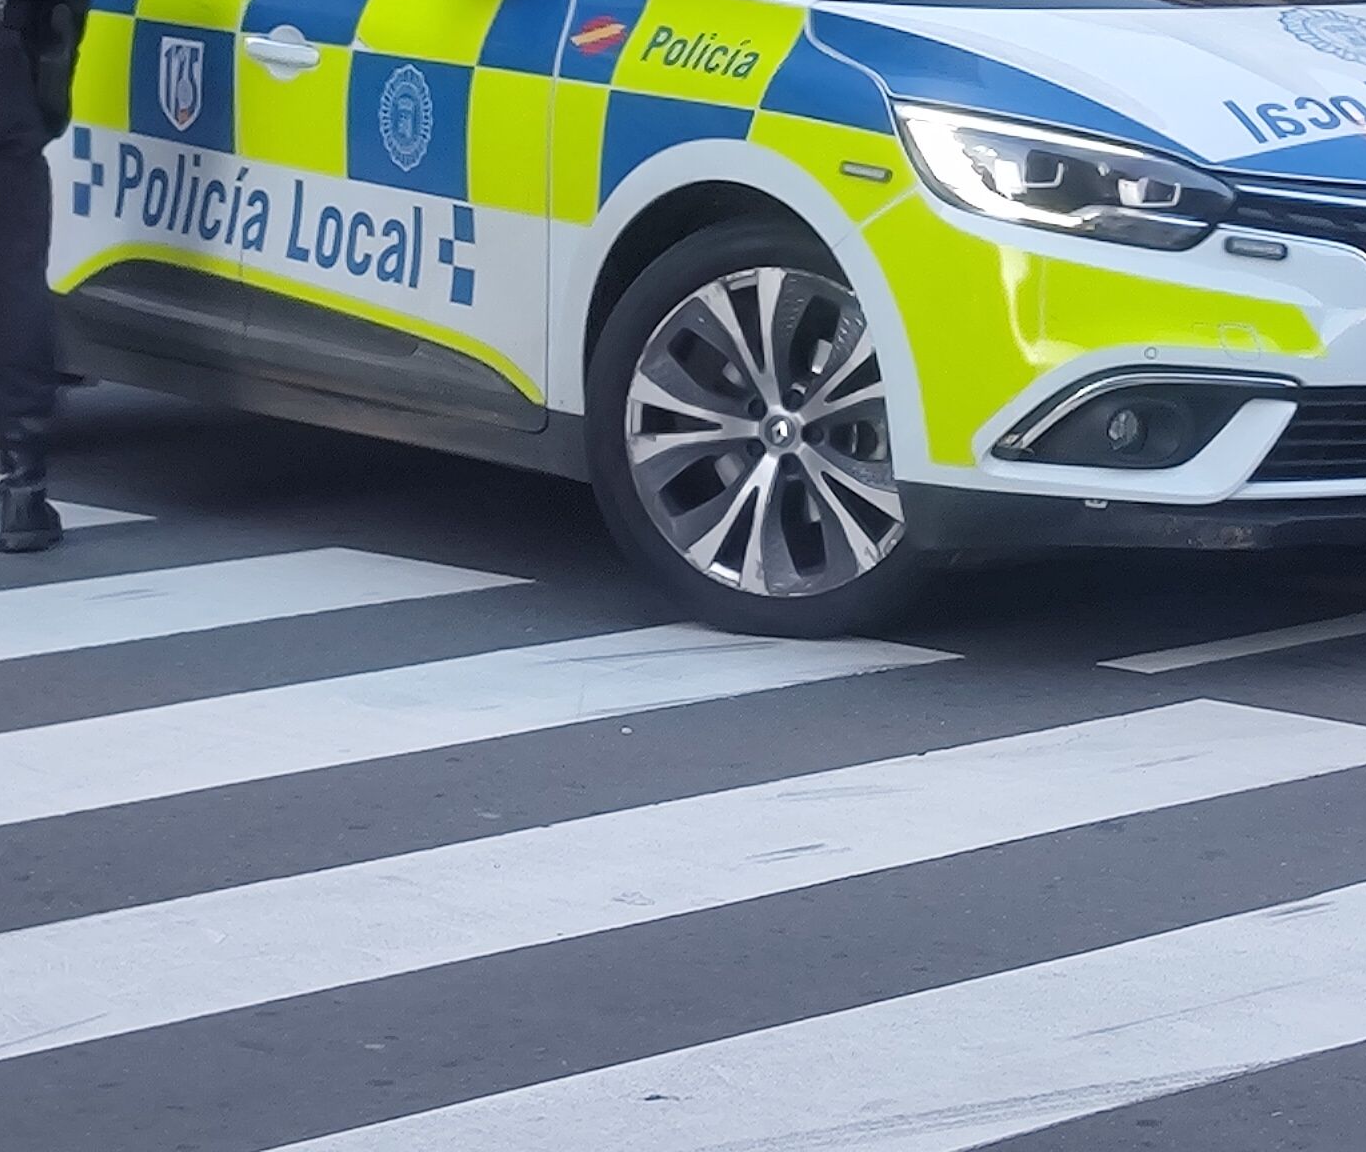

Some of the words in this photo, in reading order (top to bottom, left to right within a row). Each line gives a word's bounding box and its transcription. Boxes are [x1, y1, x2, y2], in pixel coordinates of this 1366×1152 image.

[639, 24, 761, 80] Policía
[114, 142, 270, 252] Policía
[286, 178, 424, 289] Local
